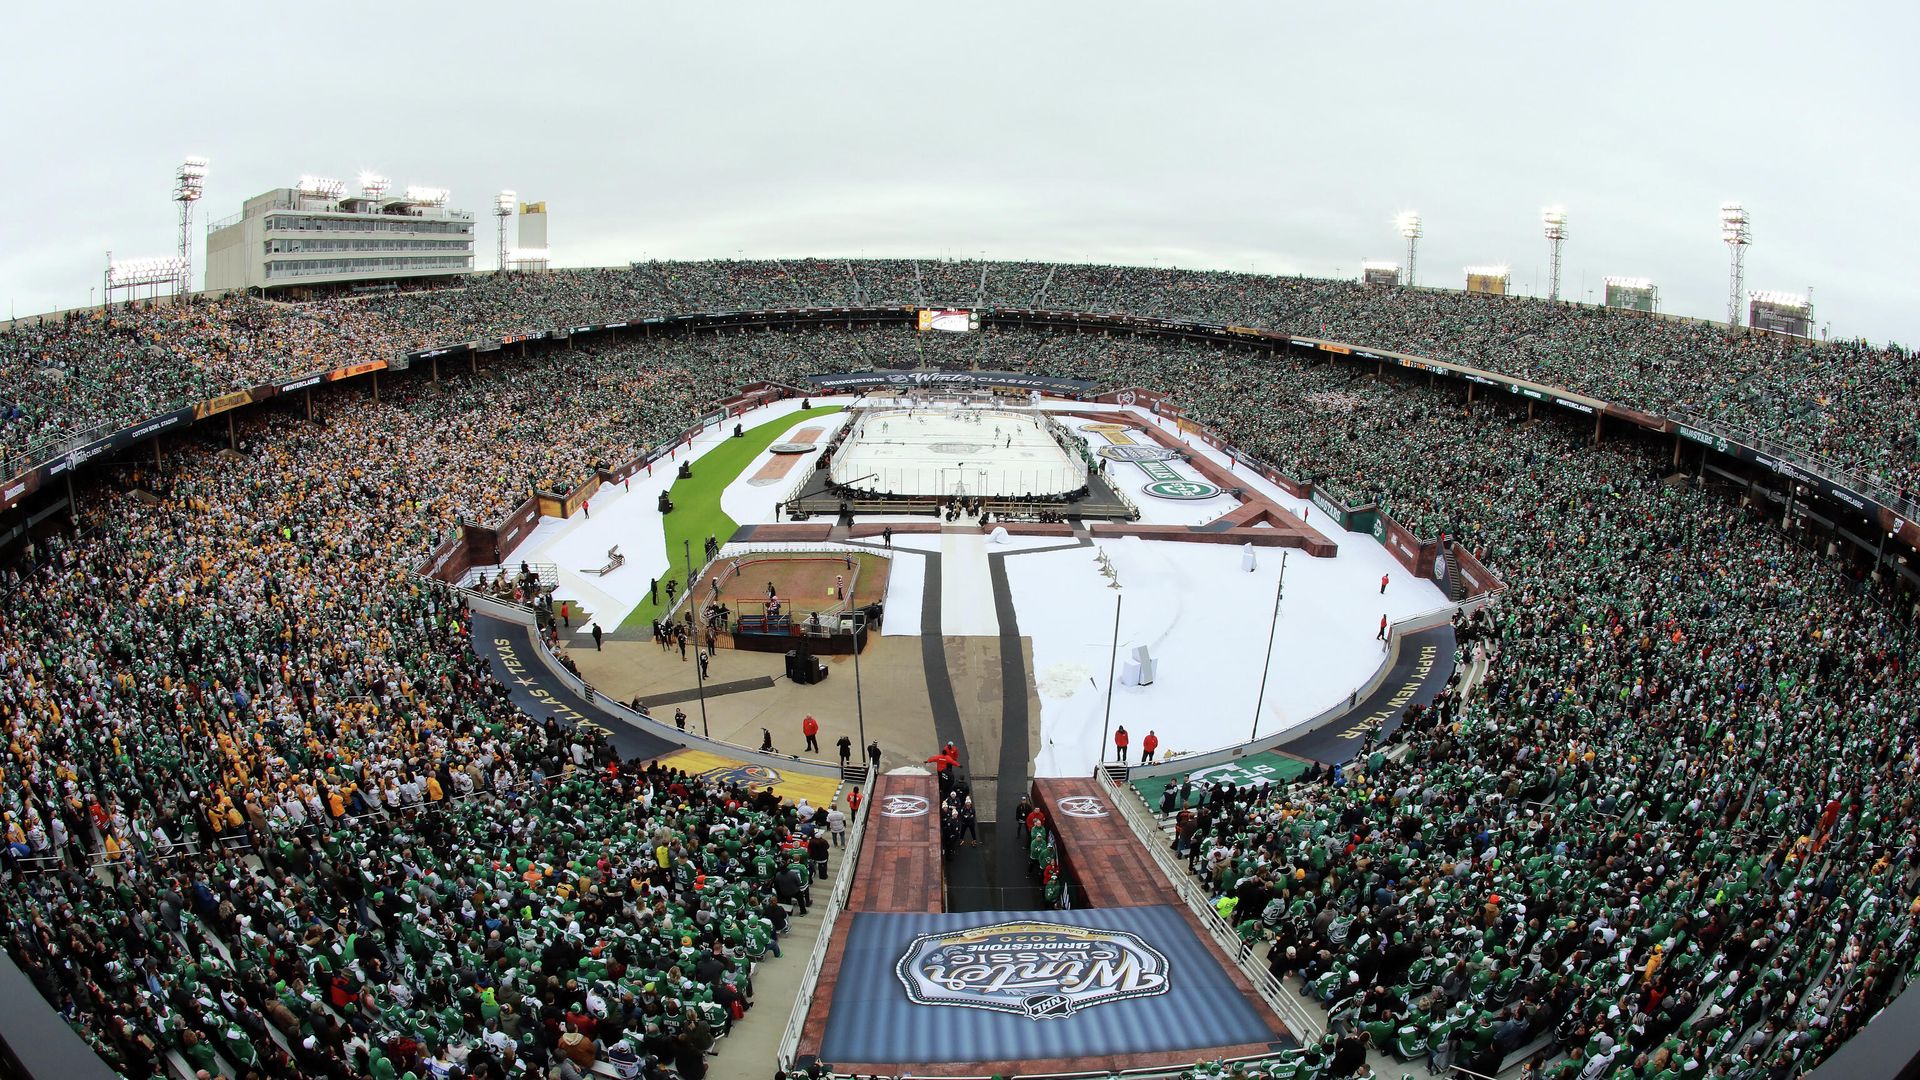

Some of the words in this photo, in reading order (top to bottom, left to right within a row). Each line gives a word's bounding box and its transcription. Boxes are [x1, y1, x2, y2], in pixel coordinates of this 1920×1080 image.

[282, 377, 321, 392] #WINTERCLASSIC
[821, 377, 885, 386] BRIDGESTONE
[978, 376, 1043, 386] CLASSIC
[131, 427, 149, 439] COTTON
[149, 423, 161, 433] BOWL
[161, 416, 179, 428] STADIUM
[1693, 431, 1713, 445] STARS
[86, 446, 103, 459] CLASSIC
[1323, 500, 1341, 521] STARS
[494, 638, 527, 675] TEXAS
[1410, 645, 1437, 680] HAPPY
[1387, 682, 1422, 709] NEW
[529, 688, 615, 736] DALLAS
[1336, 710, 1396, 740] YEAR
[1000, 935, 1057, 943] 2020
[1035, 925, 1085, 935] DALLAS
[966, 942, 1091, 952] BRIDGESTONE
[949, 950, 1116, 965] CLASSIC
[922, 949, 1165, 993] Winter
[1032, 996, 1061, 1014] NHL
